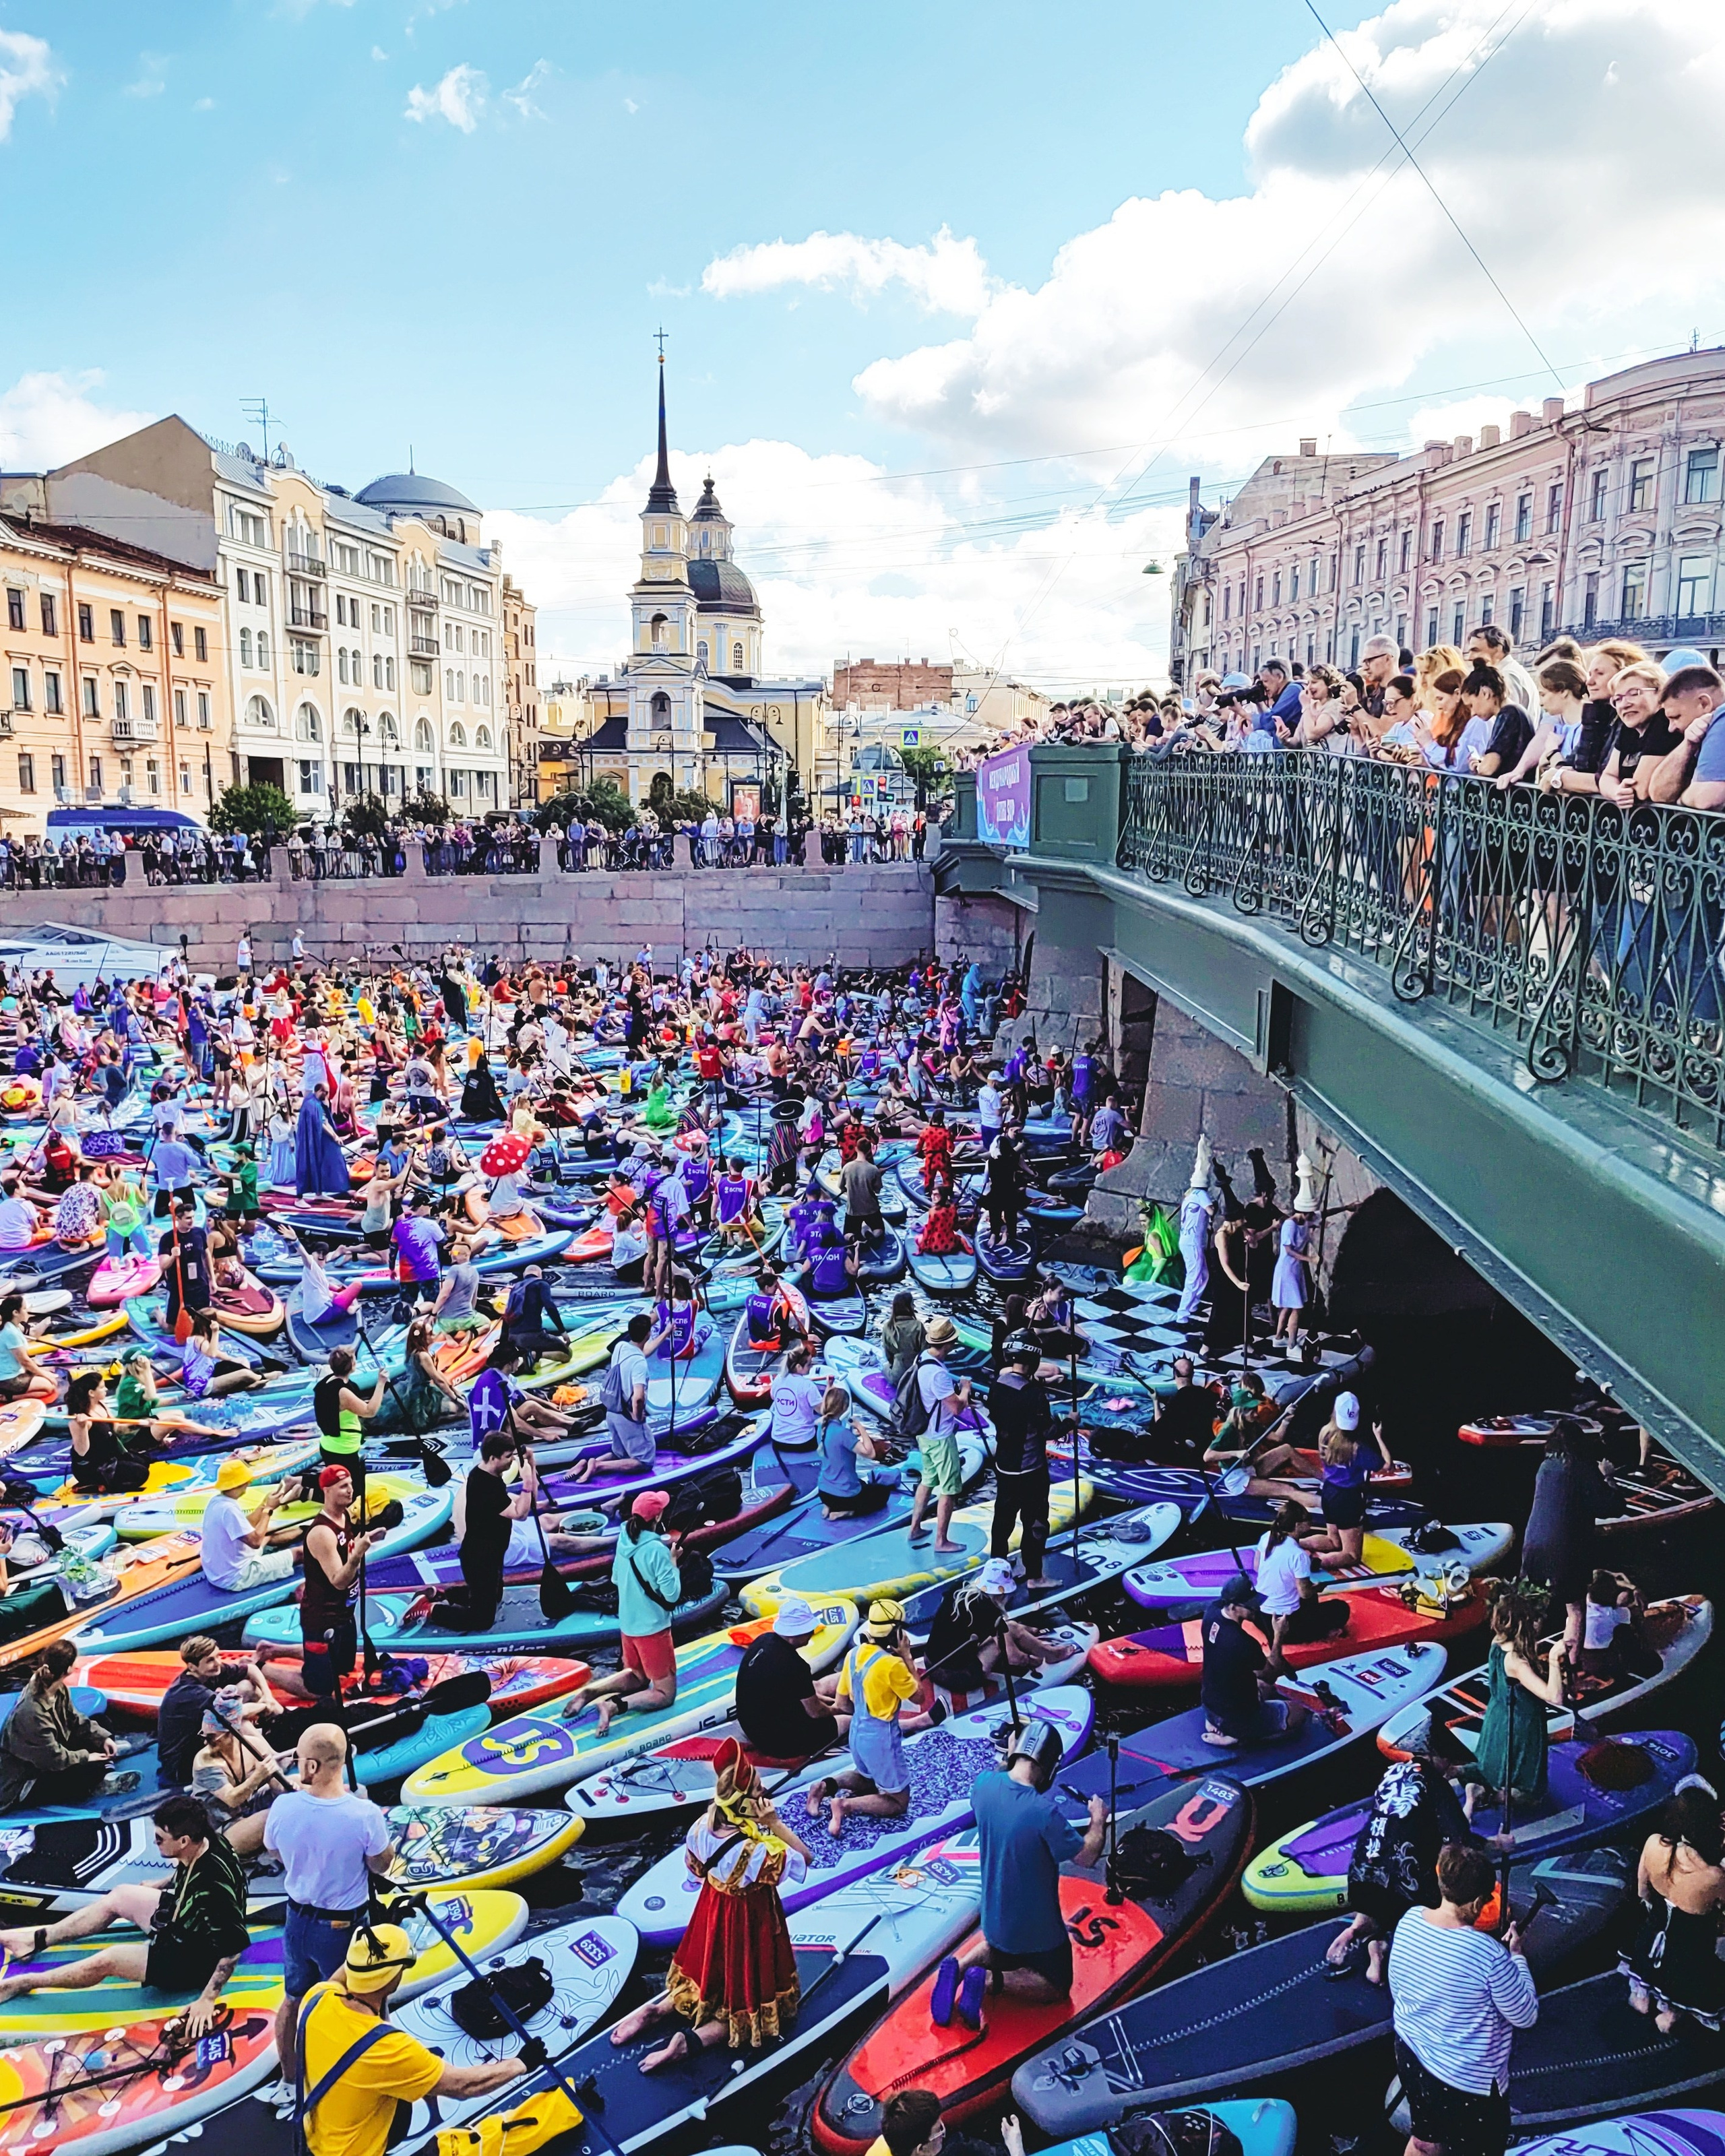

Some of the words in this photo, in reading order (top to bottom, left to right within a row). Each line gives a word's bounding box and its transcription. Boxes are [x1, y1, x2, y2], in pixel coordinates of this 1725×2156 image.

[753, 1300, 767, 1309] БСПБ
[1360, 1672, 1385, 1683] red
[639, 1734, 672, 1752] BOARD
[1648, 1742, 1676, 1759] 3014
[1206, 1784, 1234, 1801] 1483
[931, 1862, 956, 1881] 1439
[447, 1899, 463, 1922] 1390
[579, 1938, 606, 1962] 5339
[208, 2035, 222, 2061] 3415
